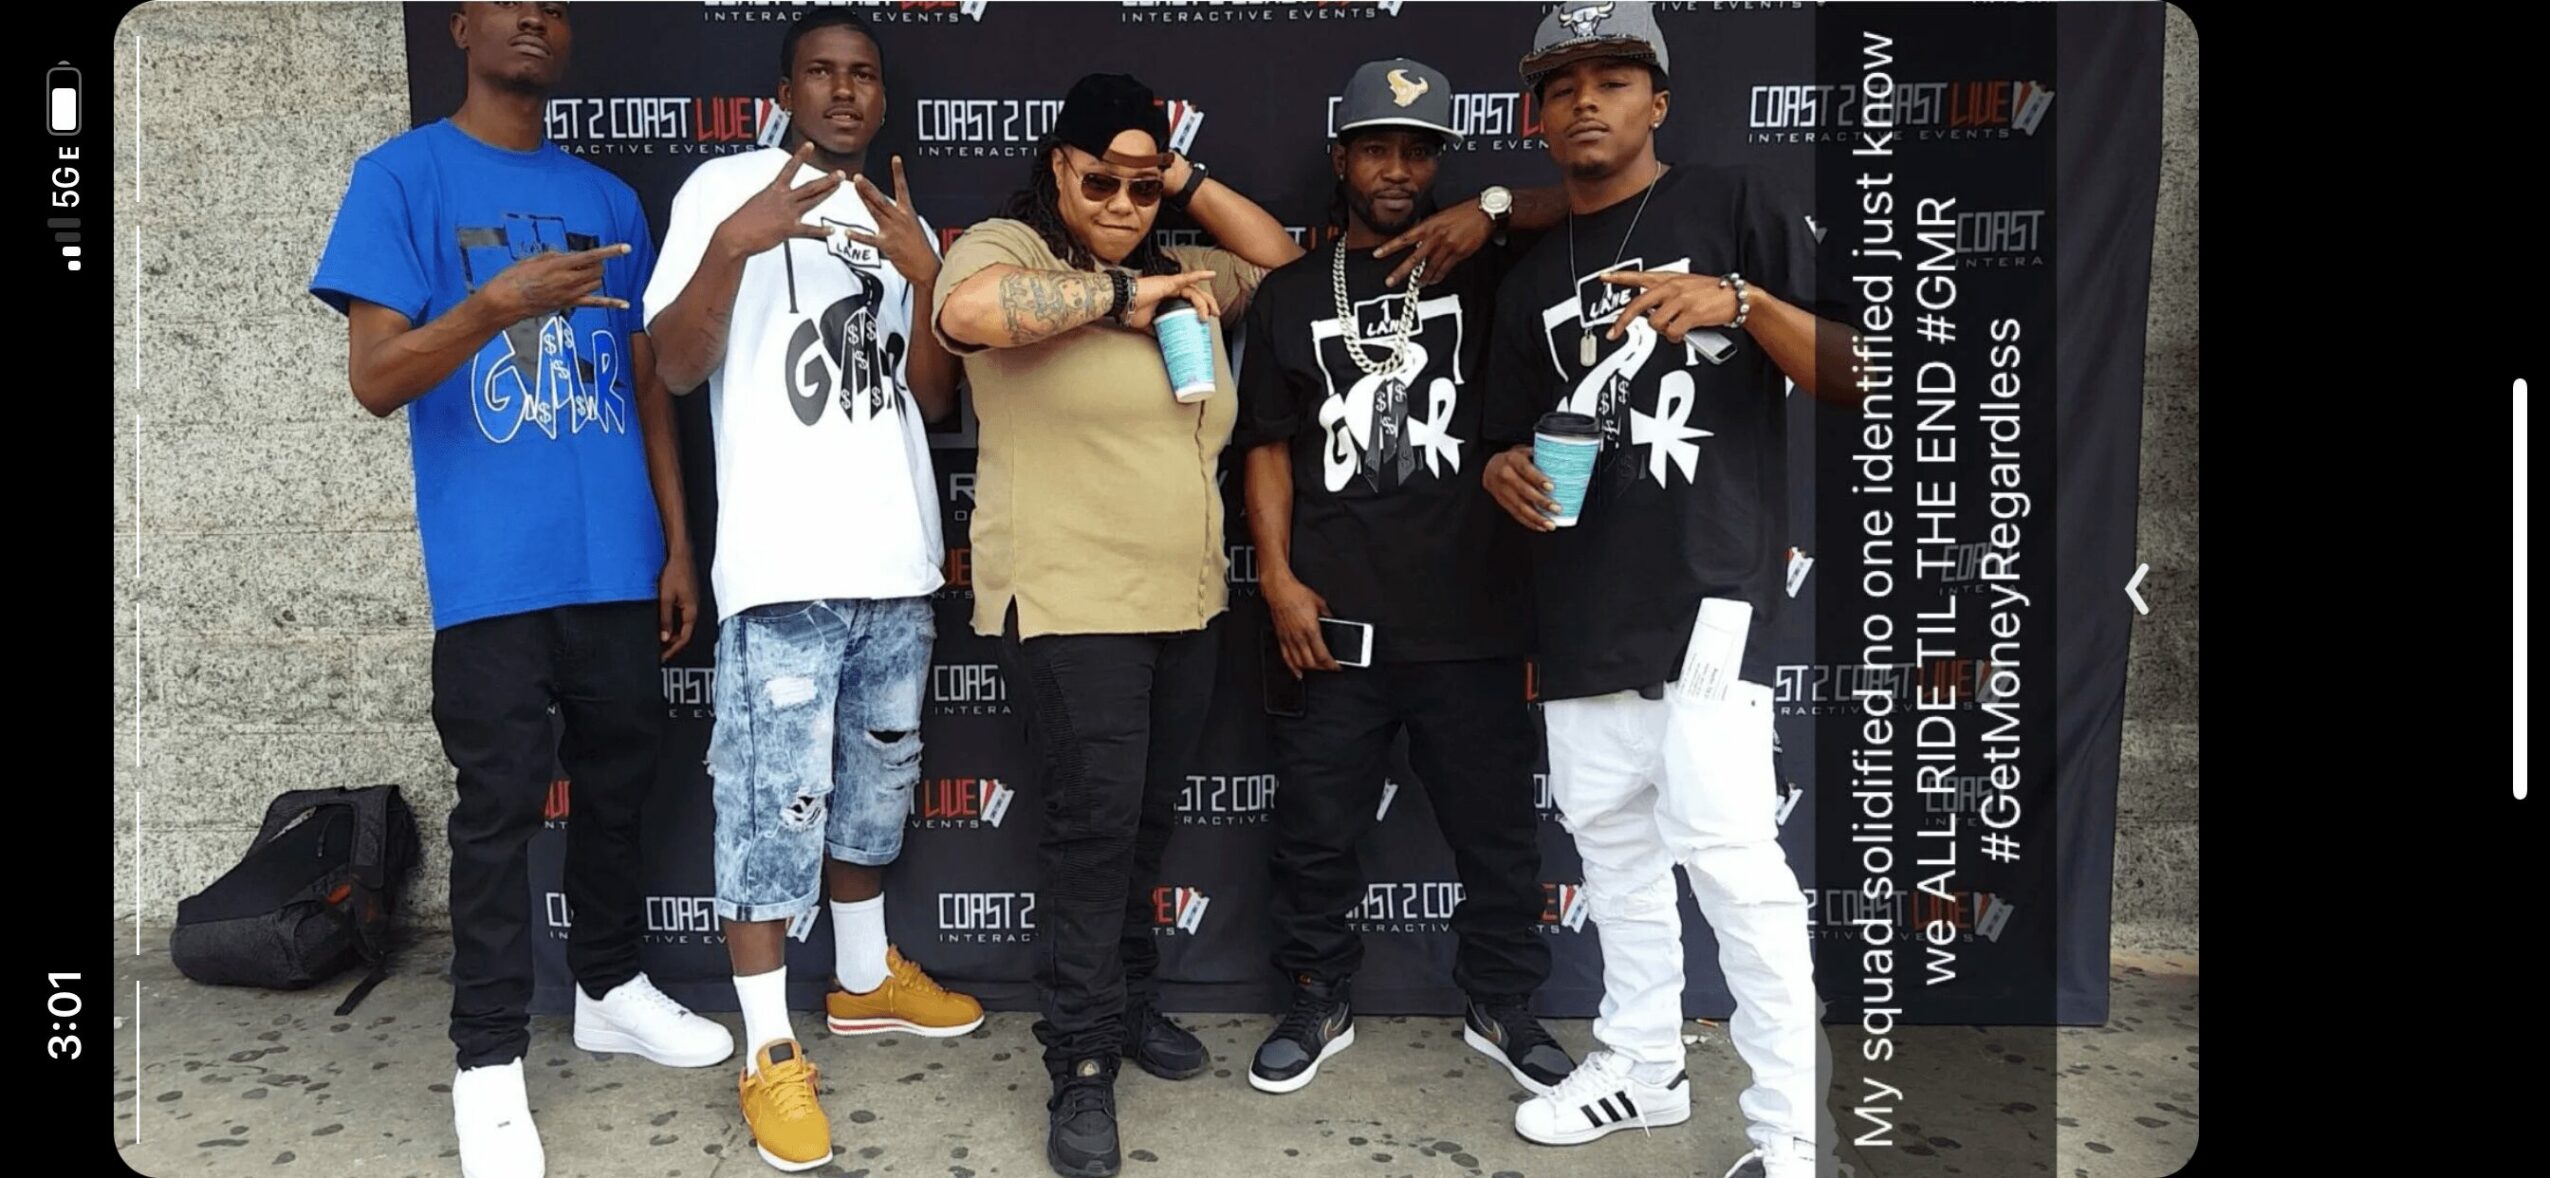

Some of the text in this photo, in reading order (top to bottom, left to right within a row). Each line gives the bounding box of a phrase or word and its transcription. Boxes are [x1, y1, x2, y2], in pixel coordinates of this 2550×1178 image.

[872, 12, 959, 23] EVENTS
[1122, 8, 1375, 22] INTERACTIVE EVENTS
[588, 98, 605, 139] 2
[611, 97, 691, 139] COAST
[695, 97, 751, 142] LIVE
[917, 99, 998, 142] COAST
[1003, 99, 1019, 142] 2
[1452, 93, 1520, 137] OAST
[1751, 86, 1834, 127] COAST
[1838, 84, 1856, 126] 2
[1952, 81, 2010, 127] LIVE
[560, 143, 756, 154] RACTIVE EVENTS
[1919, 128, 2009, 140] EVENTS
[1955, 210, 2045, 253] COAST
[836, 242, 871, 261] LANE
[1379, 299, 1391, 324] 1
[1589, 288, 1632, 318] LANE
[1366, 319, 1401, 336] LAN
[1813, 664, 1830, 702] 2
[923, 778, 977, 818] LIVE
[1211, 776, 1226, 812] 2
[912, 820, 979, 829] VENTS
[938, 892, 1036, 929] COAST 2
[1403, 883, 1418, 918] 2
